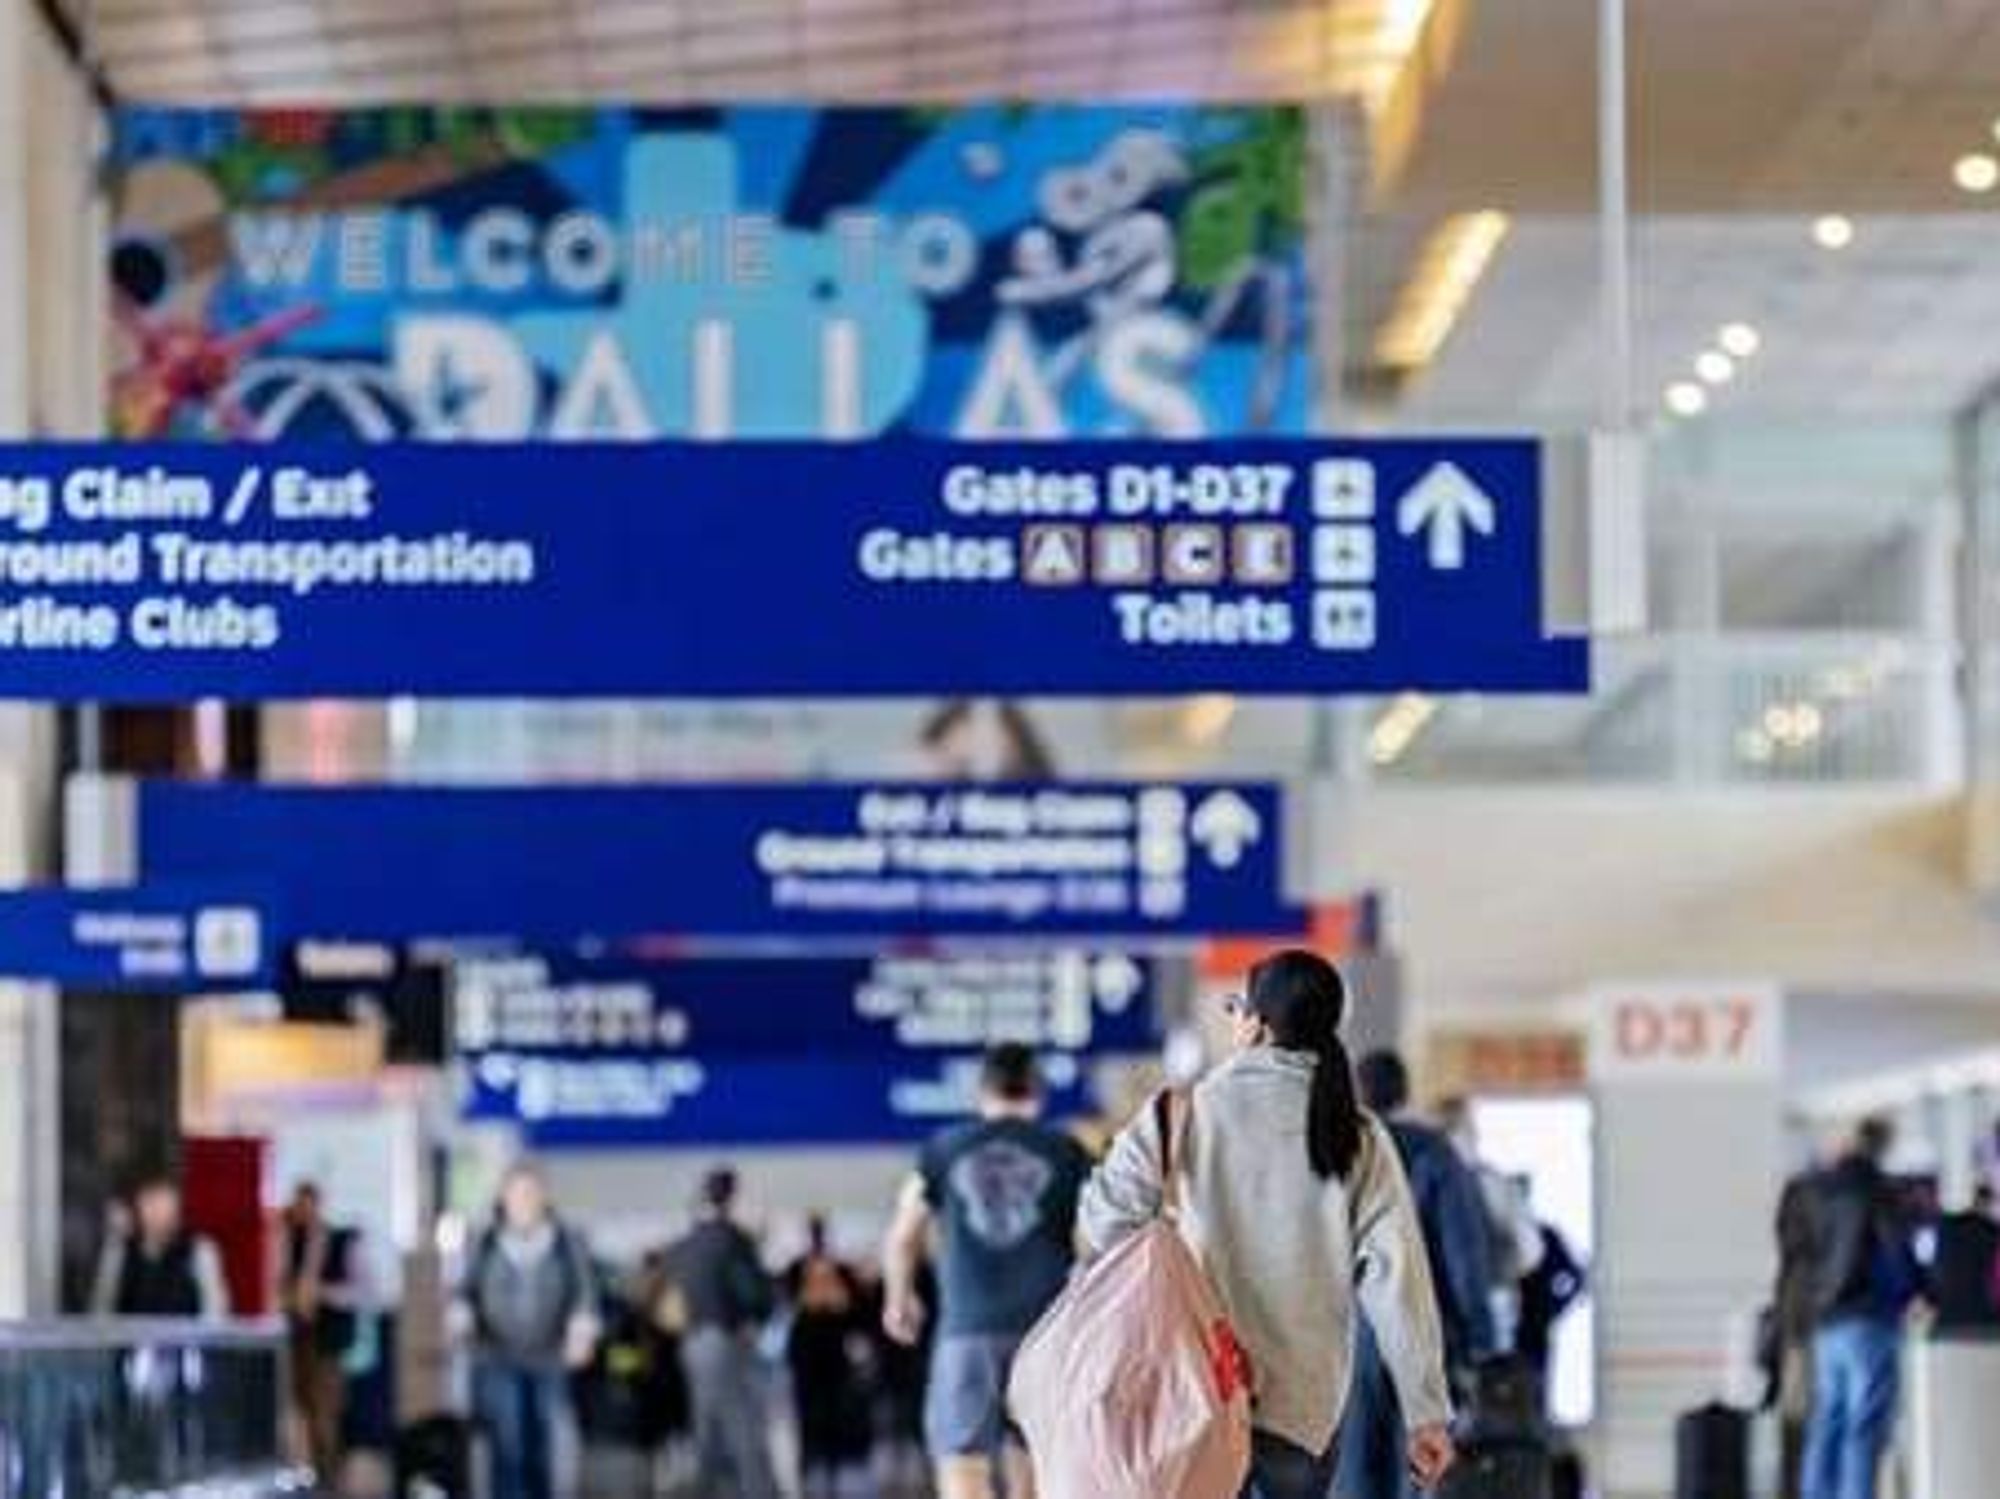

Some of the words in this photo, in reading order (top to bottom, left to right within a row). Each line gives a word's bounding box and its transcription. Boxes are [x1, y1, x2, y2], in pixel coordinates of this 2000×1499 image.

[230, 211, 776, 290] WELCOME
[818, 211, 976, 293] TO
[63, 467, 212, 519] Claim
[224, 467, 260, 524] /
[273, 469, 371, 518] Exit
[944, 465, 1097, 515] Gates
[1110, 465, 1293, 515] D1-D37
[152, 532, 534, 593] Transportation
[860, 530, 1013, 579] Gates
[131, 597, 279, 647] Clubs
[1114, 594, 1293, 643] Toilets
[1615, 998, 1755, 1059] D37
